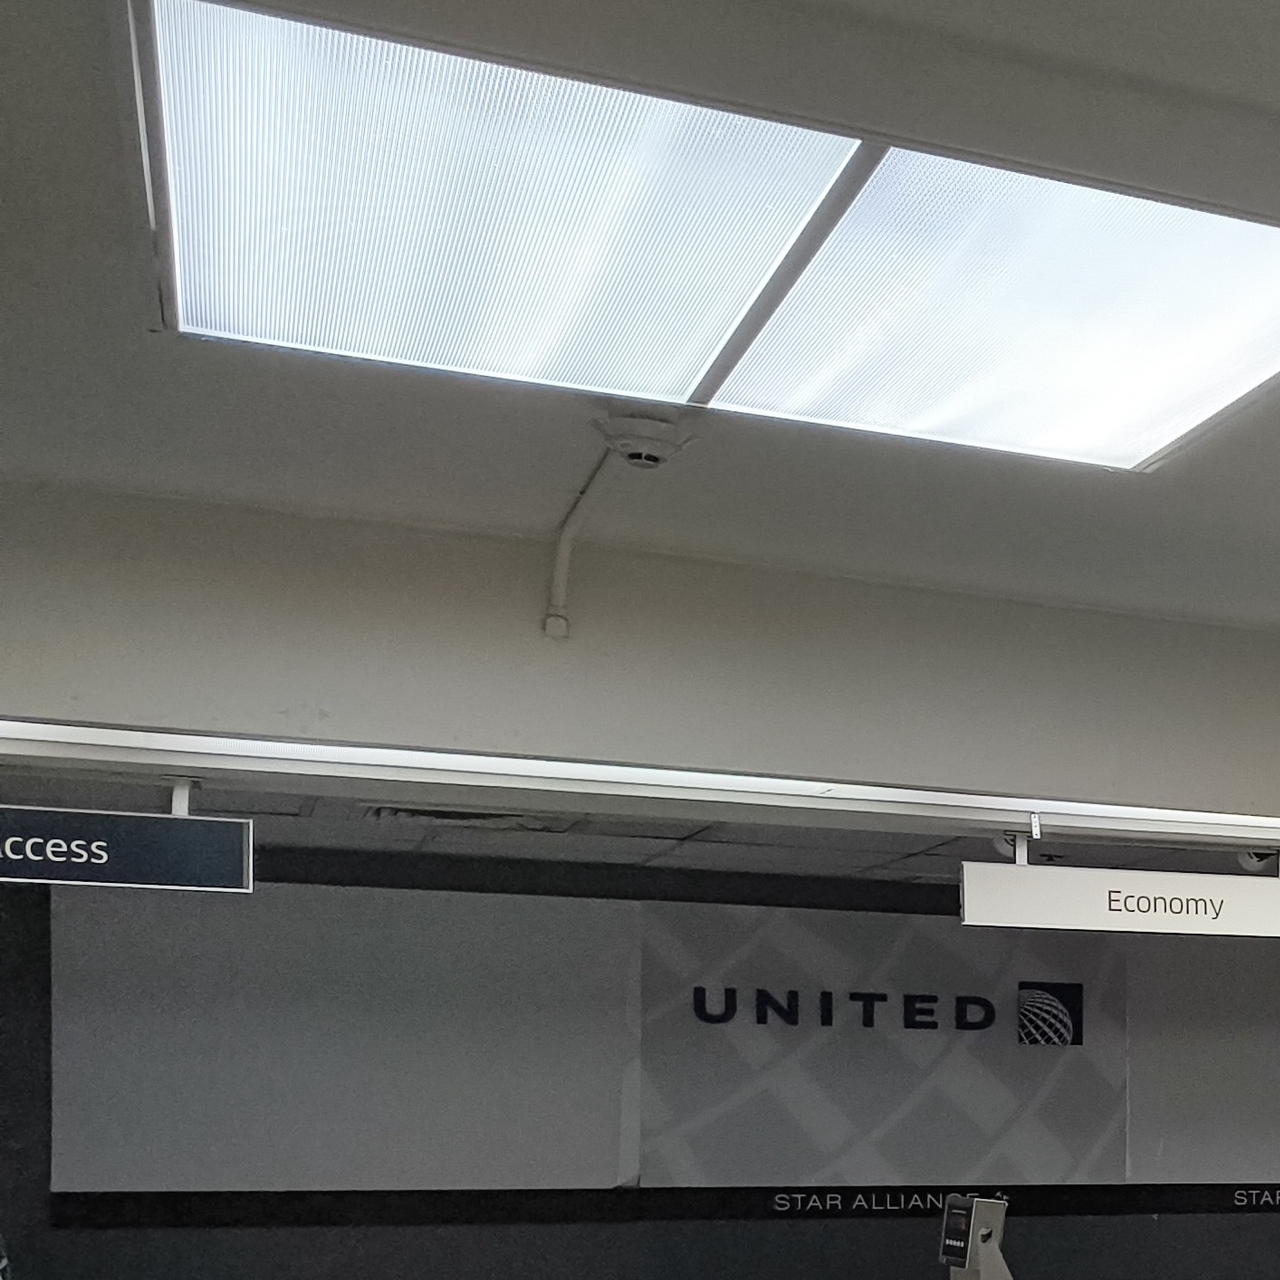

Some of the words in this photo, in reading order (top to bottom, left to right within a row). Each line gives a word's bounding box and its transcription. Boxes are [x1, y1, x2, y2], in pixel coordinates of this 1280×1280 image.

[0, 836, 109, 864] ccess
[1108, 890, 1224, 920] Economy
[693, 986, 997, 1031] UNITED
[774, 1194, 843, 1210] STAR
[852, 1193, 980, 1209] ALLIAN
